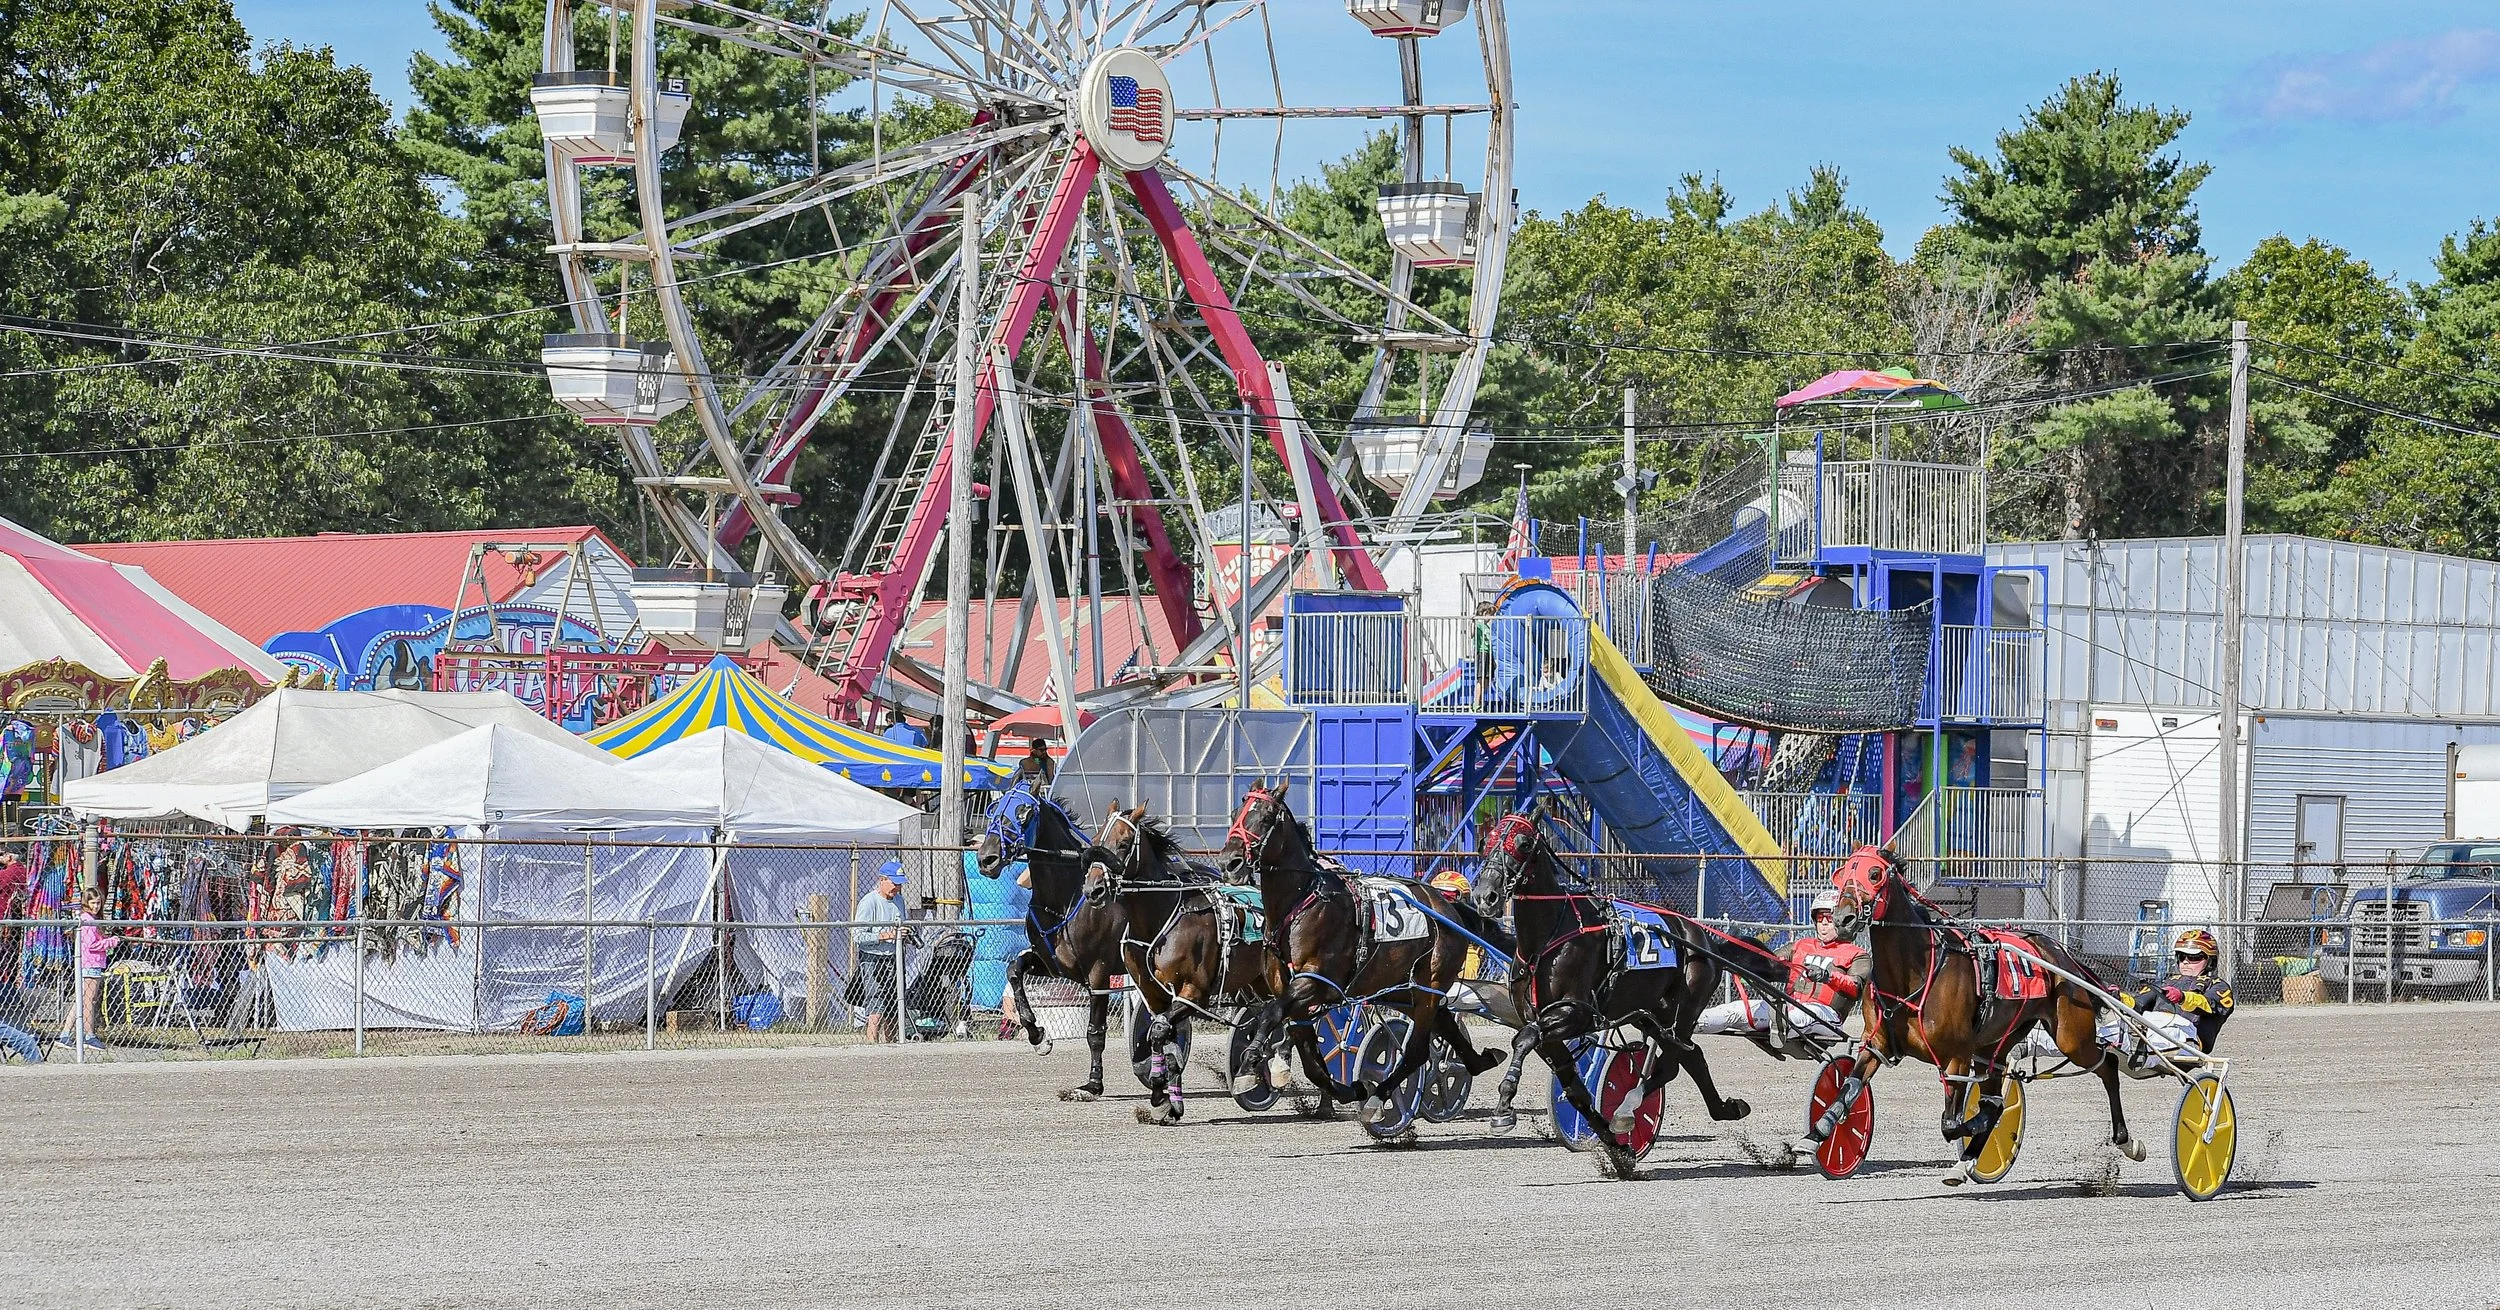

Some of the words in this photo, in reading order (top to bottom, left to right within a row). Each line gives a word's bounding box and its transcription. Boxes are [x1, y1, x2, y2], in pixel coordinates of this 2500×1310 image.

[667, 78, 684, 93] 15
[763, 571, 776, 585] 2
[497, 623, 557, 662] ICE
[1631, 925, 1658, 963] 2
